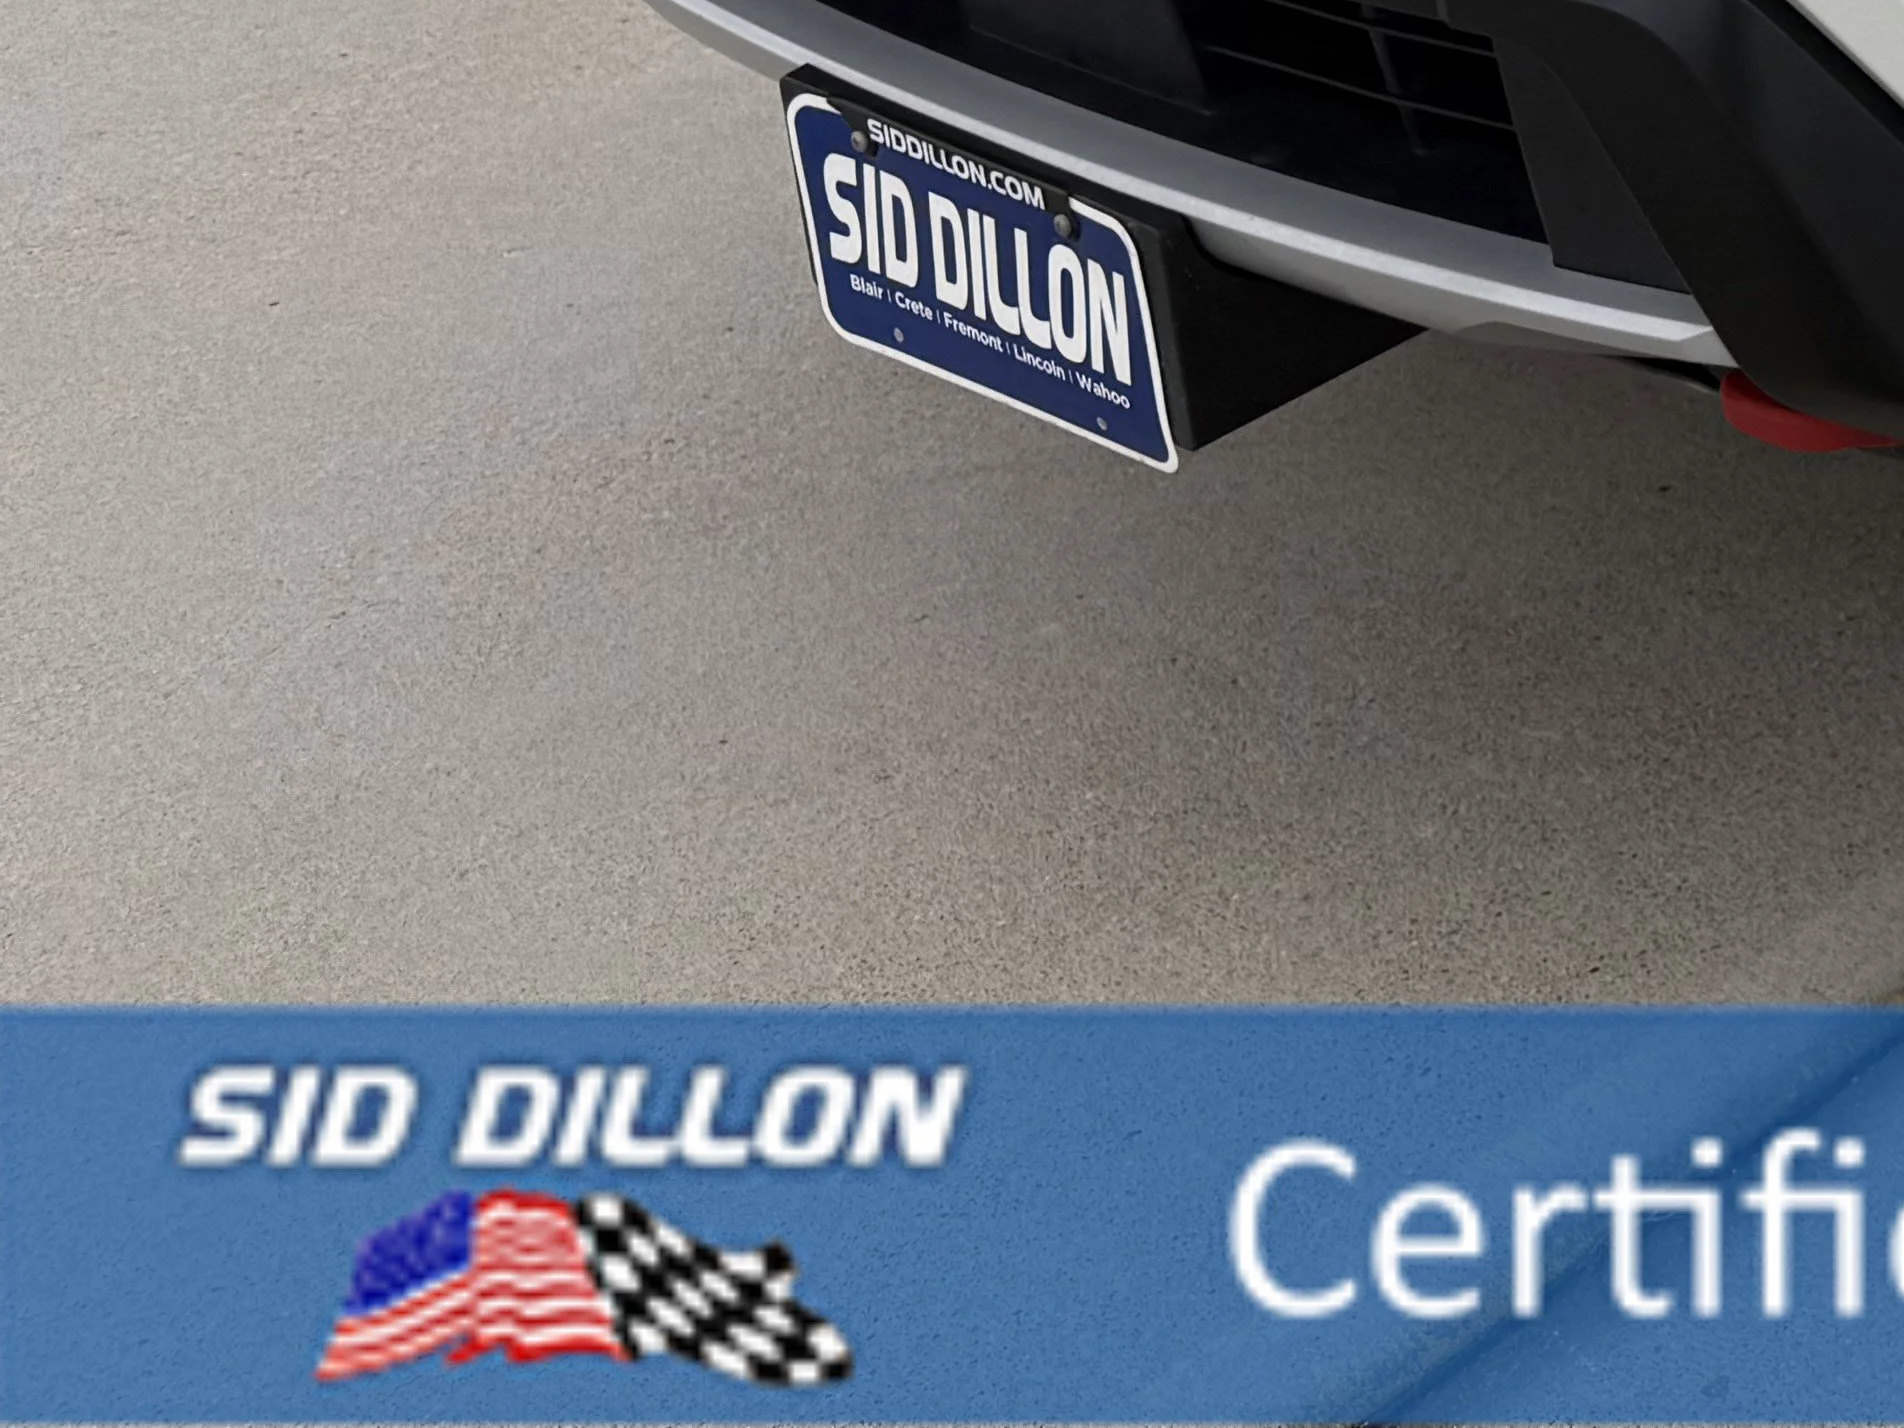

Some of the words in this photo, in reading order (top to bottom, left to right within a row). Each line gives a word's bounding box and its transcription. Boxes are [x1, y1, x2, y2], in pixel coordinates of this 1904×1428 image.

[866, 118, 1047, 211] SIDDILLON.COM
[823, 152, 919, 289] SID
[927, 190, 1133, 387] DILLON
[849, 273, 884, 301] Blair
[895, 292, 934, 321] Crete
[943, 312, 1003, 353] Fremont
[1012, 342, 1067, 382] Lincoln
[1075, 369, 1132, 411] Wahoo
